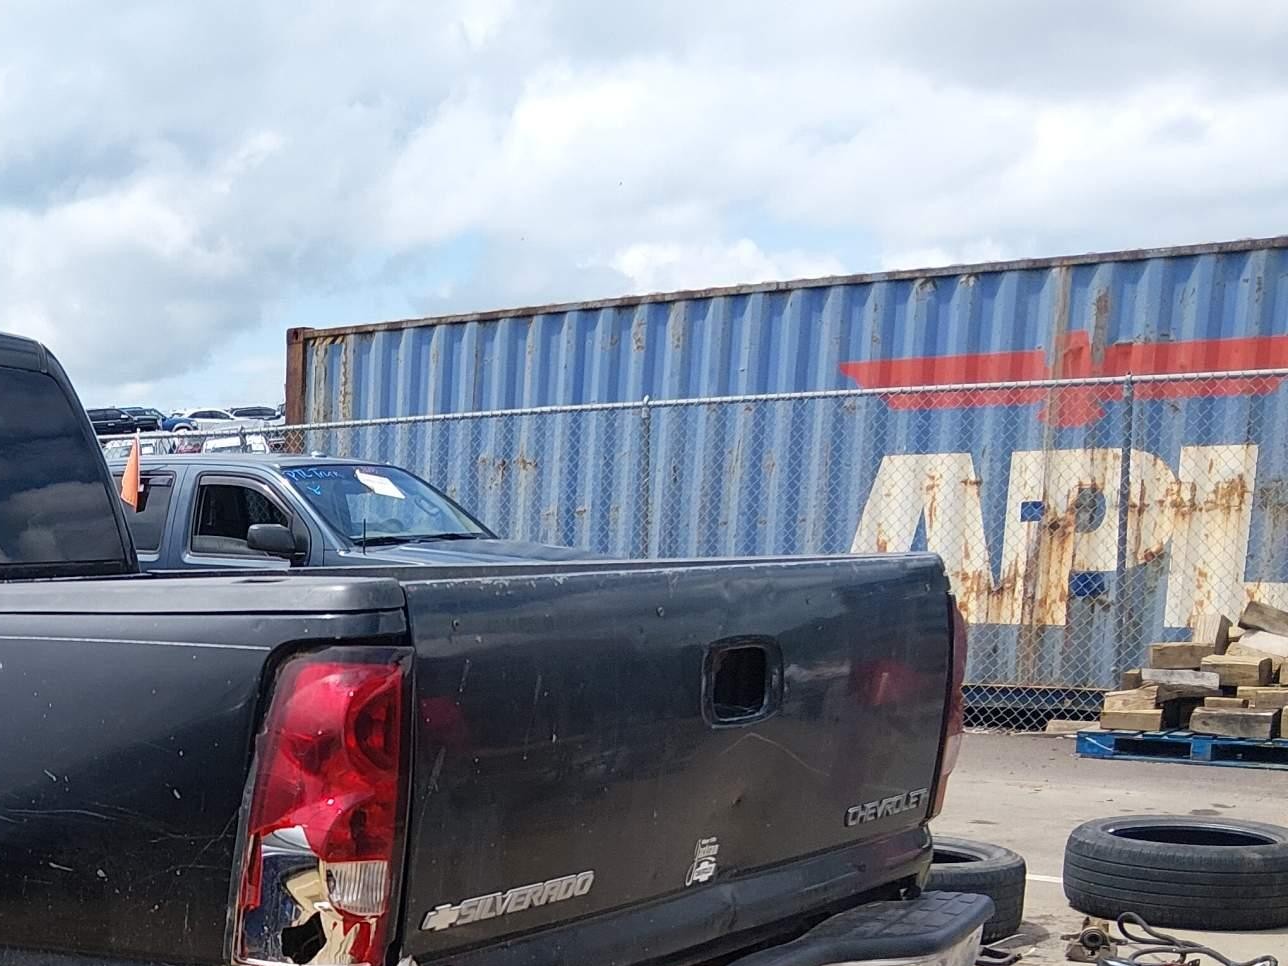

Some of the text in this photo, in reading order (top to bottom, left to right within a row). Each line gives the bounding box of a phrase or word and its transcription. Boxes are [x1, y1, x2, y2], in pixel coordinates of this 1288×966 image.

[851, 444, 1288, 629] APL
[846, 787, 929, 826] CHEVROLET
[456, 869, 595, 926] SILVERADO
